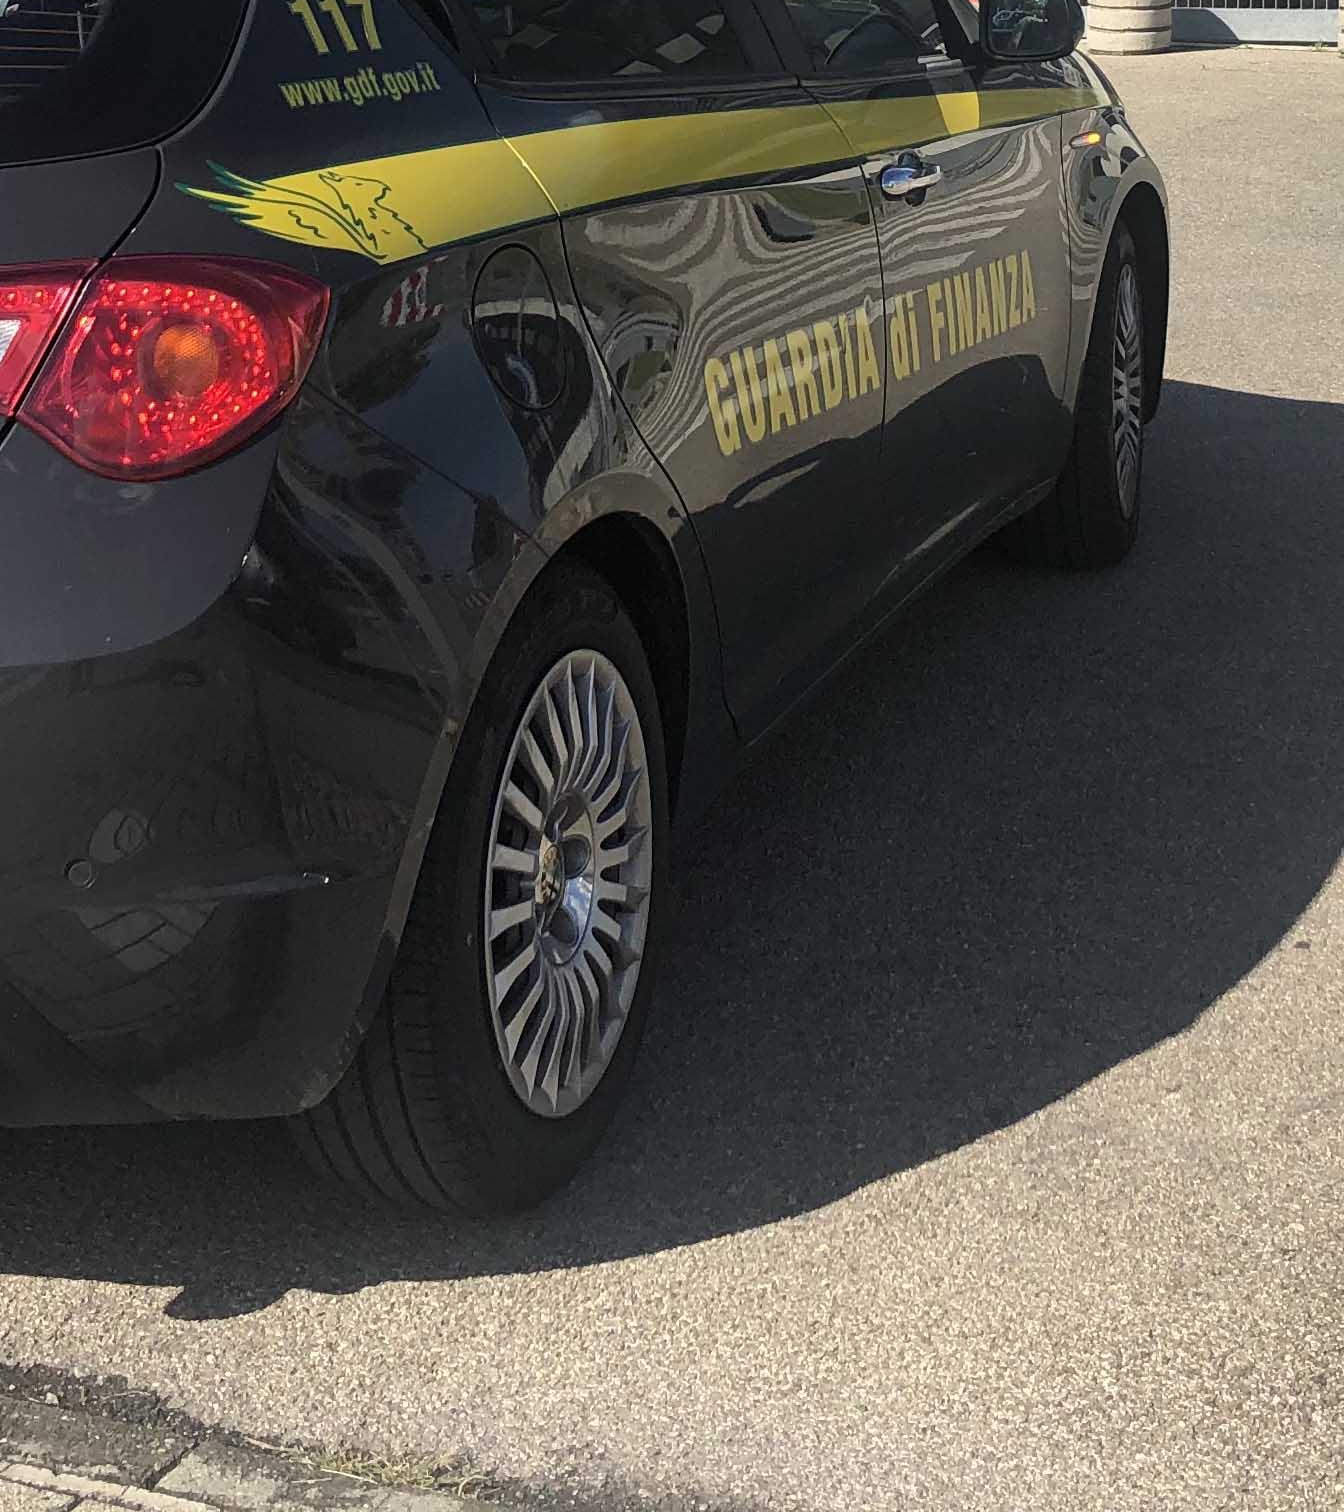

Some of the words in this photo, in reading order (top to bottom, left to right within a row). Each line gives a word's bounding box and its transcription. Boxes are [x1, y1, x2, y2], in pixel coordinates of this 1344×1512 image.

[279, 61, 441, 108] www.gdf.gov.it
[703, 305, 882, 456] GUARDIA
[889, 289, 921, 381] di
[926, 248, 1037, 363] FINANZA
